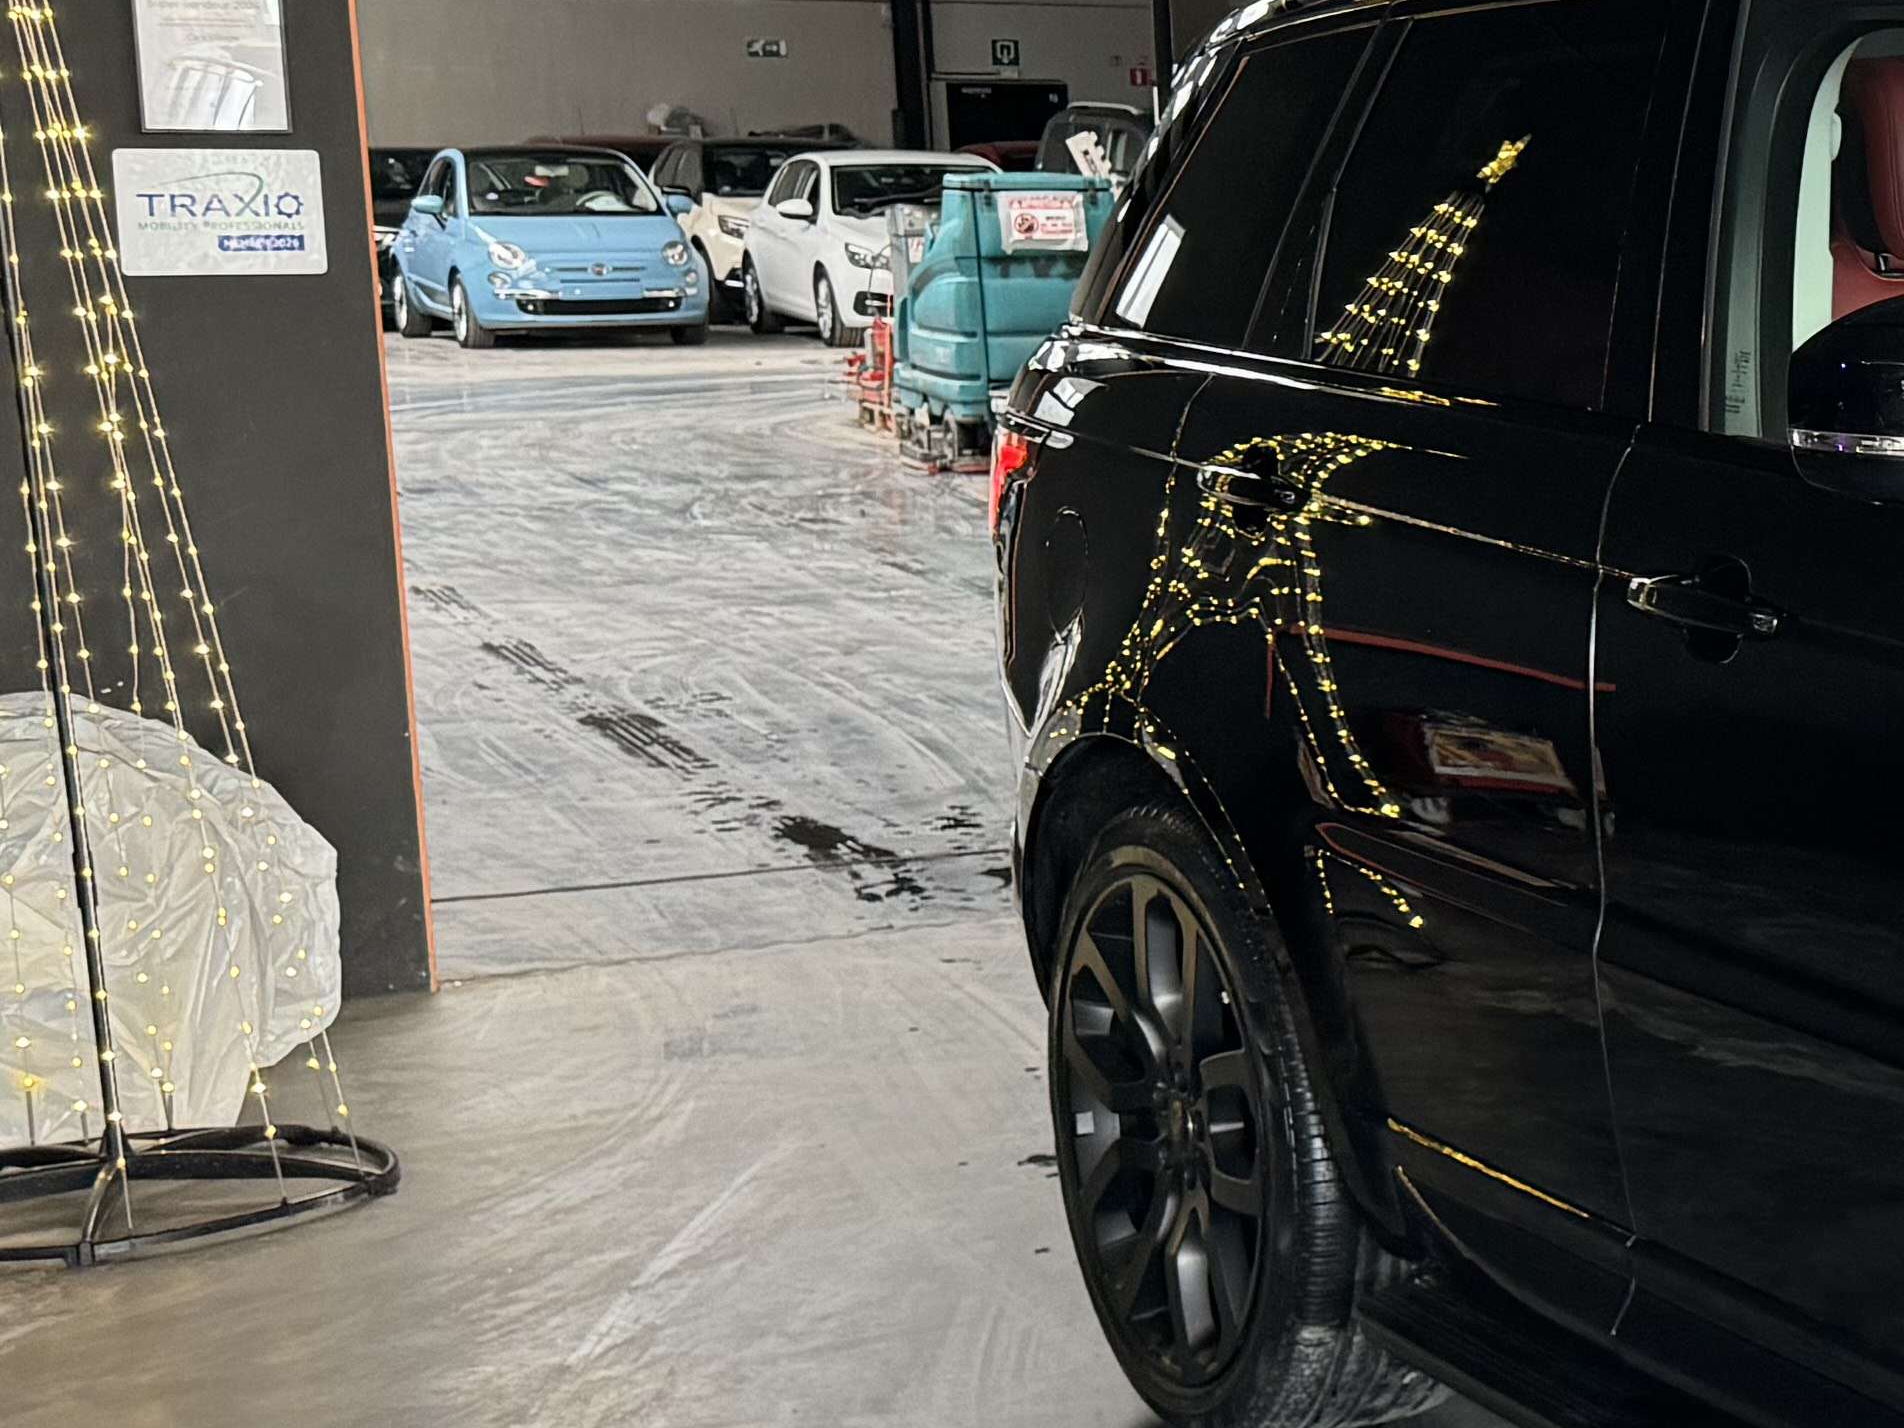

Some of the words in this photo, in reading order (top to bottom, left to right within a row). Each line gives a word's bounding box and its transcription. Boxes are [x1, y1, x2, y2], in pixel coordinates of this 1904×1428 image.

[136, 191, 304, 219] TRAXIO
[138, 221, 198, 232] MOBILITY
[203, 220, 305, 232] PROFESSIONALS
